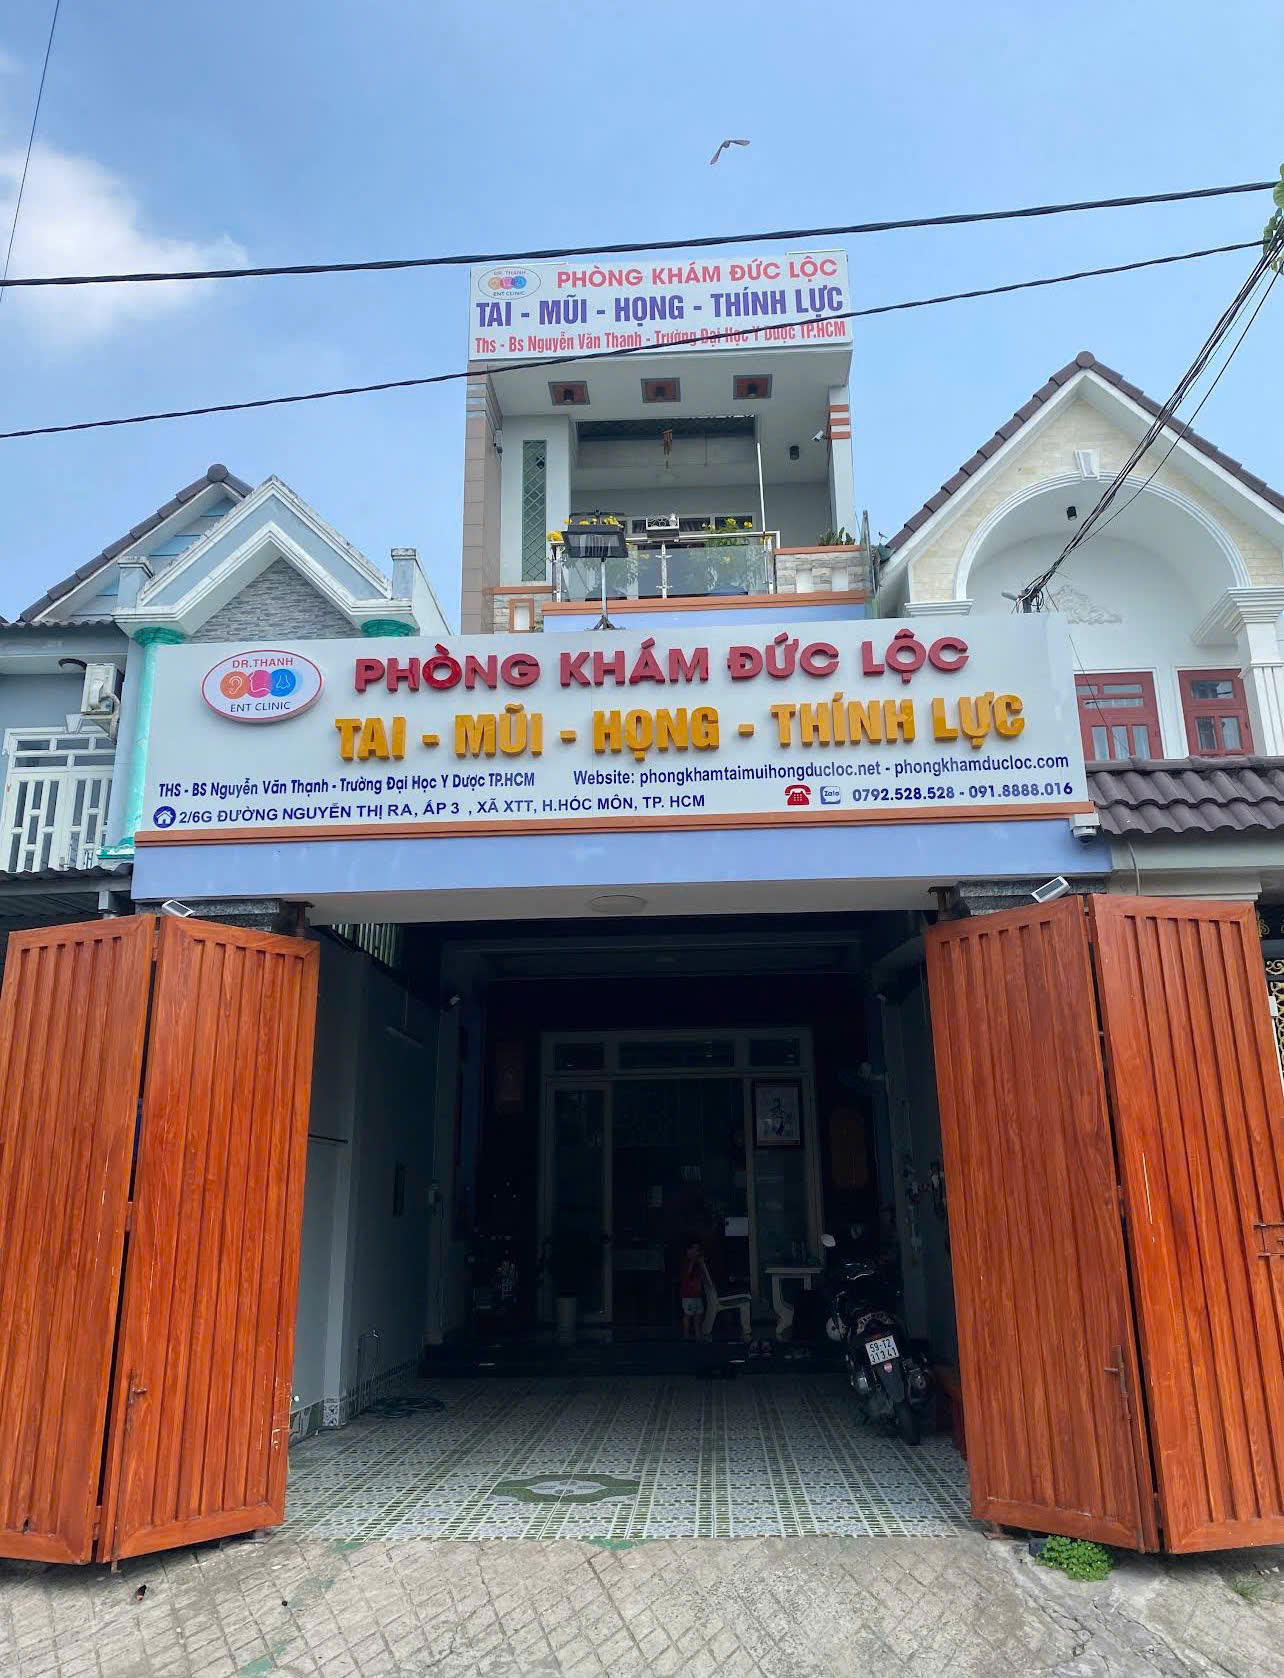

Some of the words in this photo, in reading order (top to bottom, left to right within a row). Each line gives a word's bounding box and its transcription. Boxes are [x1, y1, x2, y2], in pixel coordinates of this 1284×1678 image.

[557, 265, 643, 288] PHÒNG
[652, 261, 721, 285] KHÁM
[729, 258, 781, 281] ĐỨC
[789, 255, 838, 282] LỘC
[476, 302, 512, 327] TAI
[539, 294, 587, 325] MŨI
[615, 295, 684, 327] HỌNG
[710, 286, 787, 318] THÍNH
[795, 285, 843, 318] LỰC
[475, 337, 497, 353] Ths
[509, 336, 524, 352] Bs
[527, 331, 574, 353] Nguyễn
[578, 332, 601, 349] Văn
[752, 325, 760, 341] Y
[800, 320, 847, 339] TP.HCM
[354, 643, 541, 692] PHÒNG
[560, 637, 709, 687] KHÁM
[727, 632, 840, 681] ĐỨC
[861, 628, 970, 684] LỘC
[230, 703, 252, 712] ENT
[255, 701, 291, 711] CLINIC
[335, 717, 407, 761] TAI
[422, 734, 440, 746] -
[455, 703, 543, 758] MŨI
[560, 730, 577, 742] -
[593, 706, 720, 761] HỌNG
[738, 723, 755, 737] -
[771, 691, 916, 747] THÍNH
[932, 691, 1025, 749] LỰC
[159, 783, 181, 797] THS
[192, 782, 207, 796] BS
[210, 778, 258, 799] Nguyễn
[263, 779, 287, 795] Văn
[291, 779, 329, 797] Thạnh
[340, 776, 382, 794] Trường
[386, 776, 408, 793] Đại
[412, 776, 437, 793] Học
[441, 775, 449, 788] Y
[453, 774, 486, 791] Dược
[488, 772, 535, 787] TP.HCM
[573, 770, 635, 785] Website:
[640, 761, 881, 787] phongkhamtaimuihongducloc.net
[895, 755, 1069, 777] phongkhamducloc.com
[852, 786, 955, 801] 0792.528.528
[968, 782, 1073, 798] 091.8888.016
[178, 810, 213, 824] 2/6G
[217, 806, 278, 822] ĐƯỜNG
[282, 803, 352, 820] NGUYỄN
[357, 804, 384, 819] THỊ
[387, 803, 418, 817] RA,
[423, 800, 447, 815] ẤP
[451, 802, 460, 814] 3
[476, 799, 499, 814] XÃ
[503, 800, 537, 814] XTT,
[542, 796, 592, 812] H.HÓC
[597, 794, 638, 811] MÔN,
[642, 796, 665, 809] TP.
[669, 794, 705, 808] HCM
